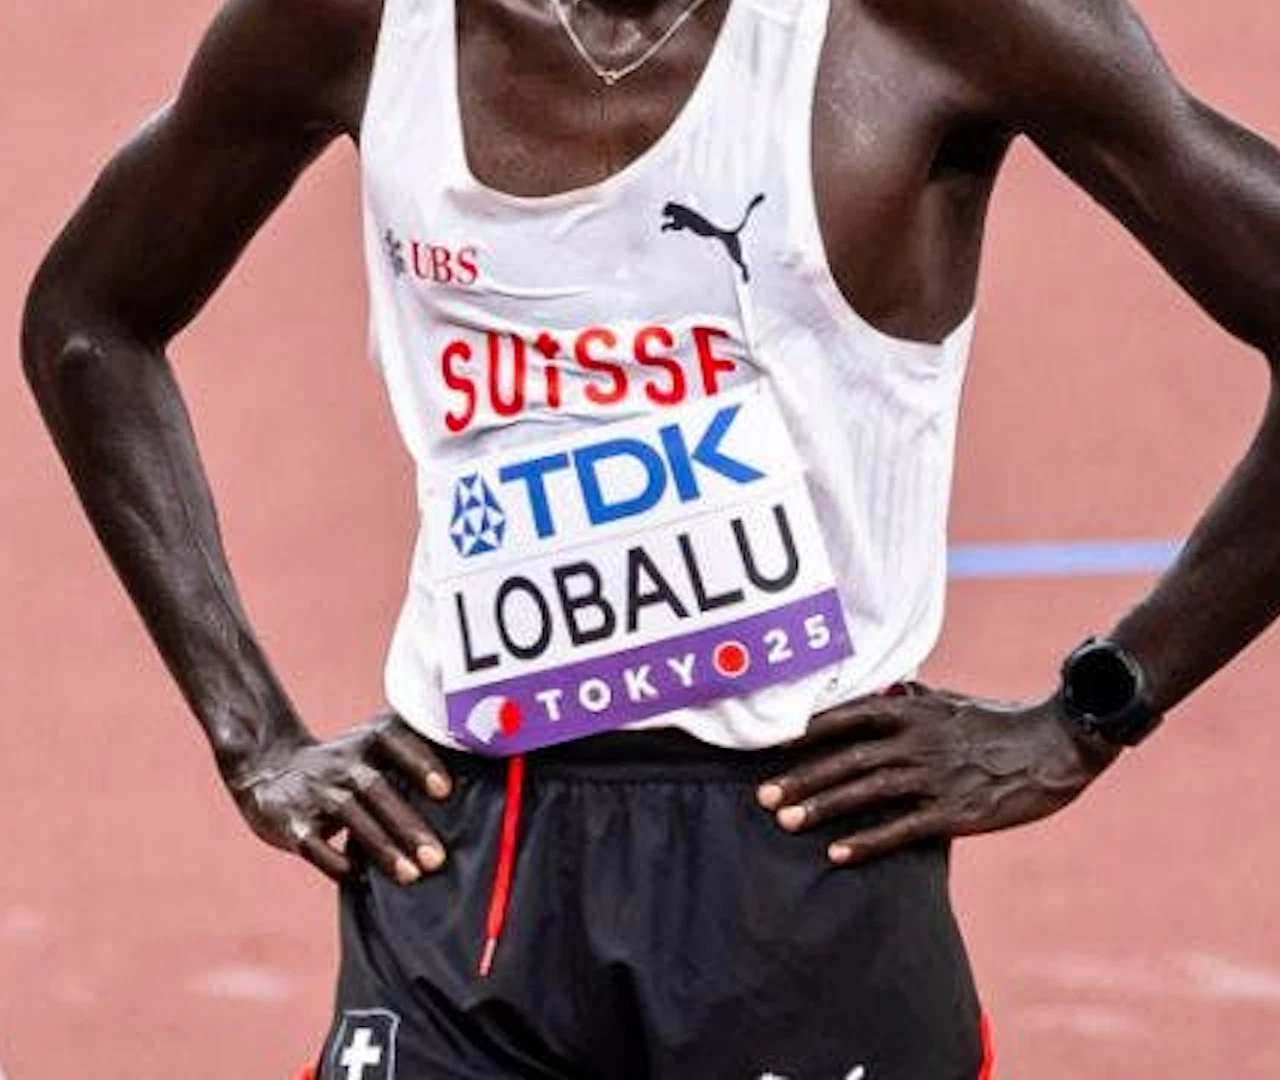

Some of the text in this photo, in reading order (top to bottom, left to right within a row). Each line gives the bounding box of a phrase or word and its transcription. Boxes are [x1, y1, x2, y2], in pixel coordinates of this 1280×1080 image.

[409, 240, 479, 286] UBS
[499, 404, 767, 541] TDK
[454, 503, 802, 674] LOBALU
